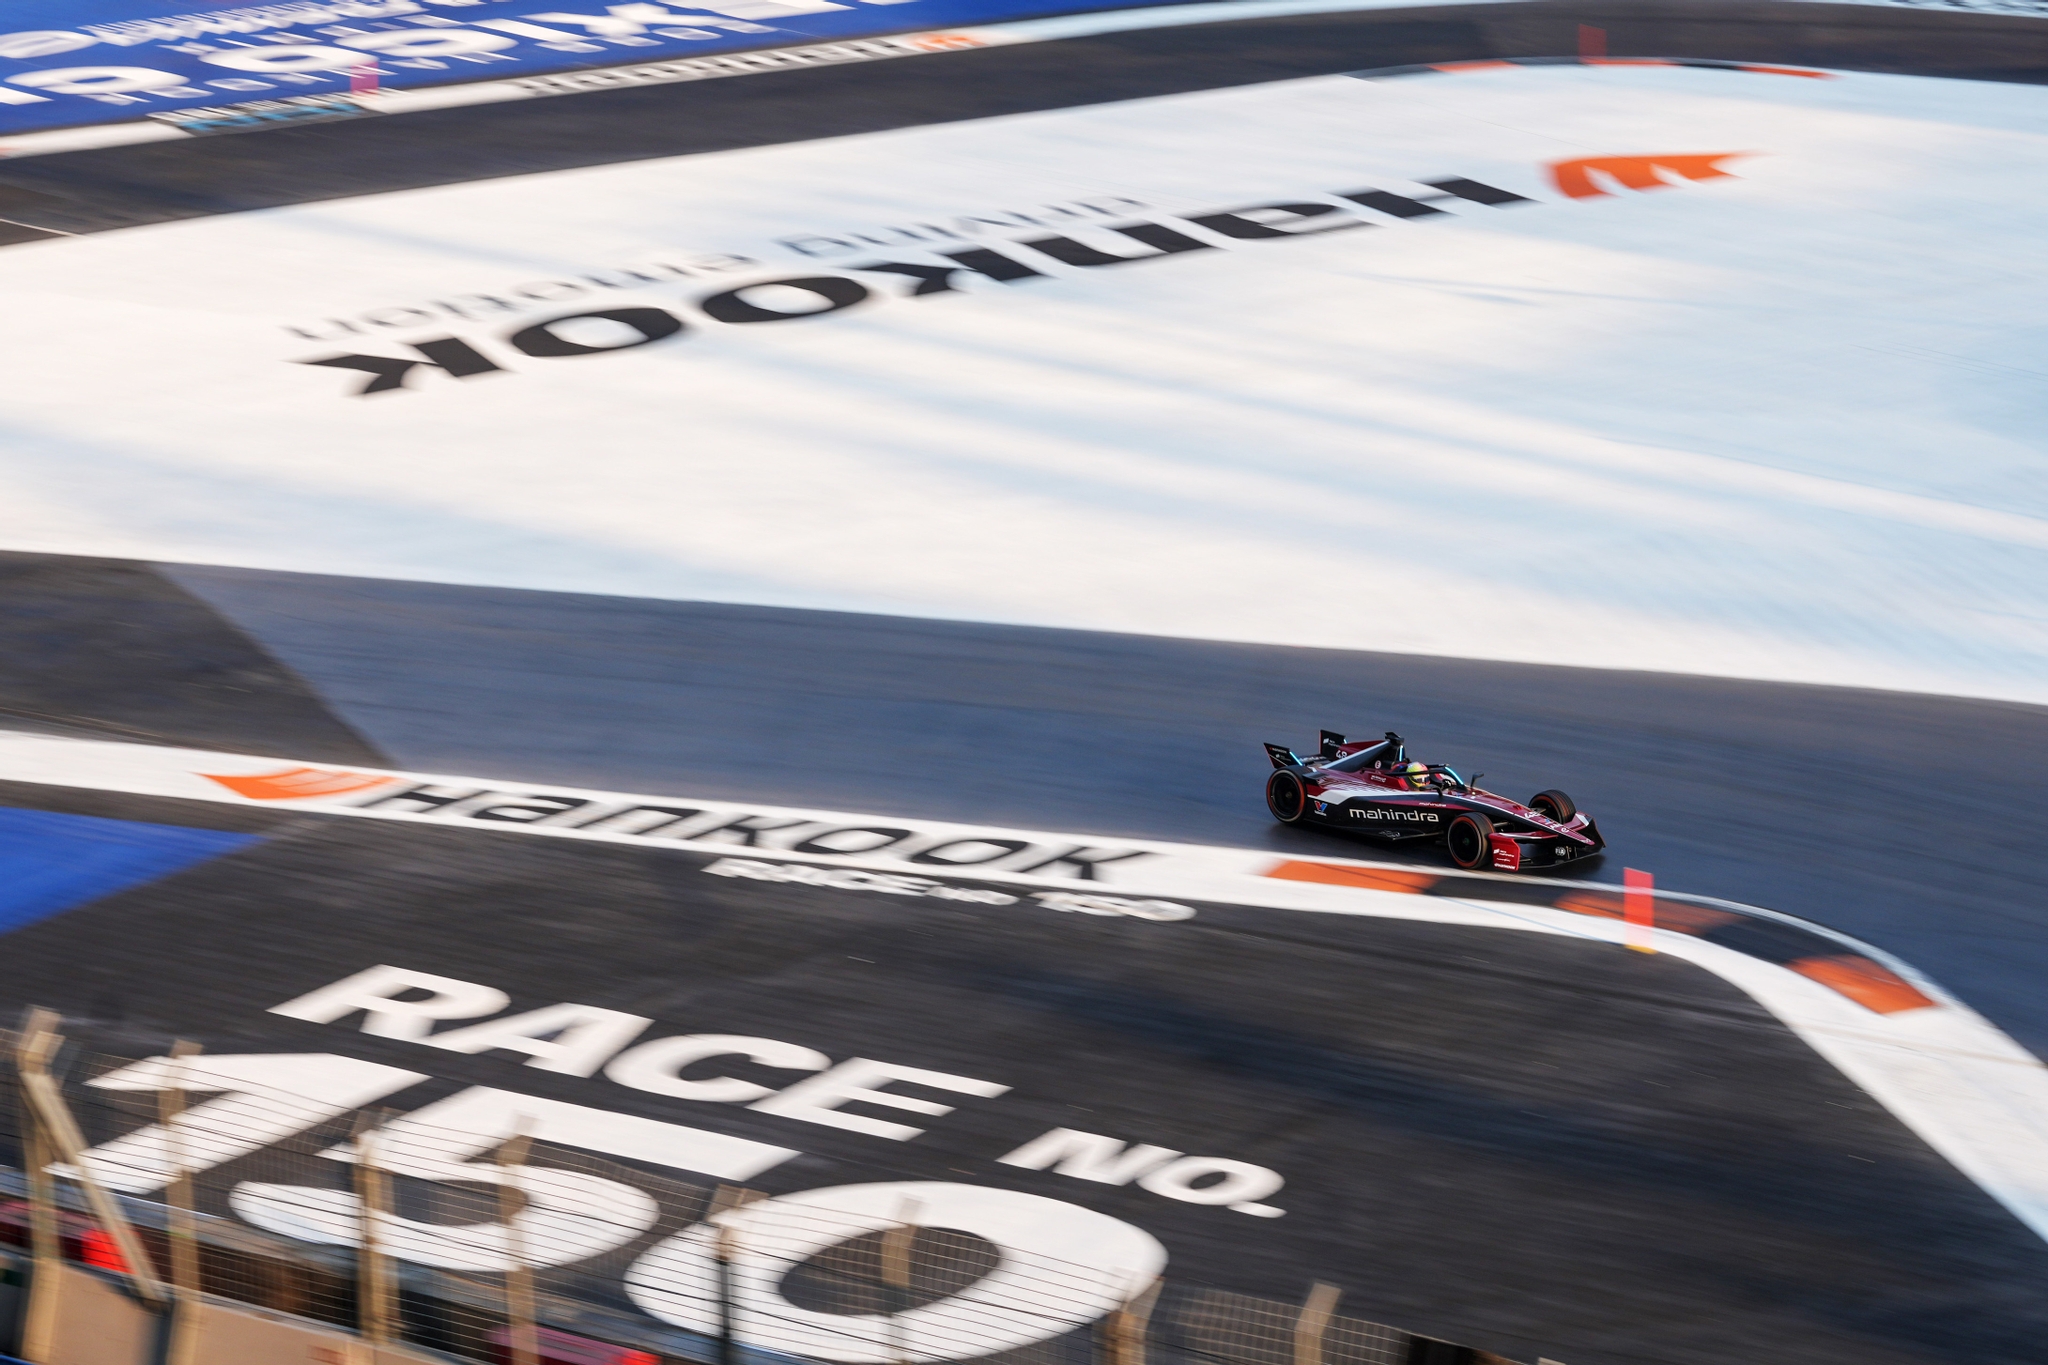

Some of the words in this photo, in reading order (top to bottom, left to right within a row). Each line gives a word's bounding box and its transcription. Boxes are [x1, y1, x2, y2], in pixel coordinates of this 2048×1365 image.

[1349, 807, 1440, 823] mahindra
[266, 963, 1014, 1141] RACE
[42, 1052, 1170, 1363] 150
